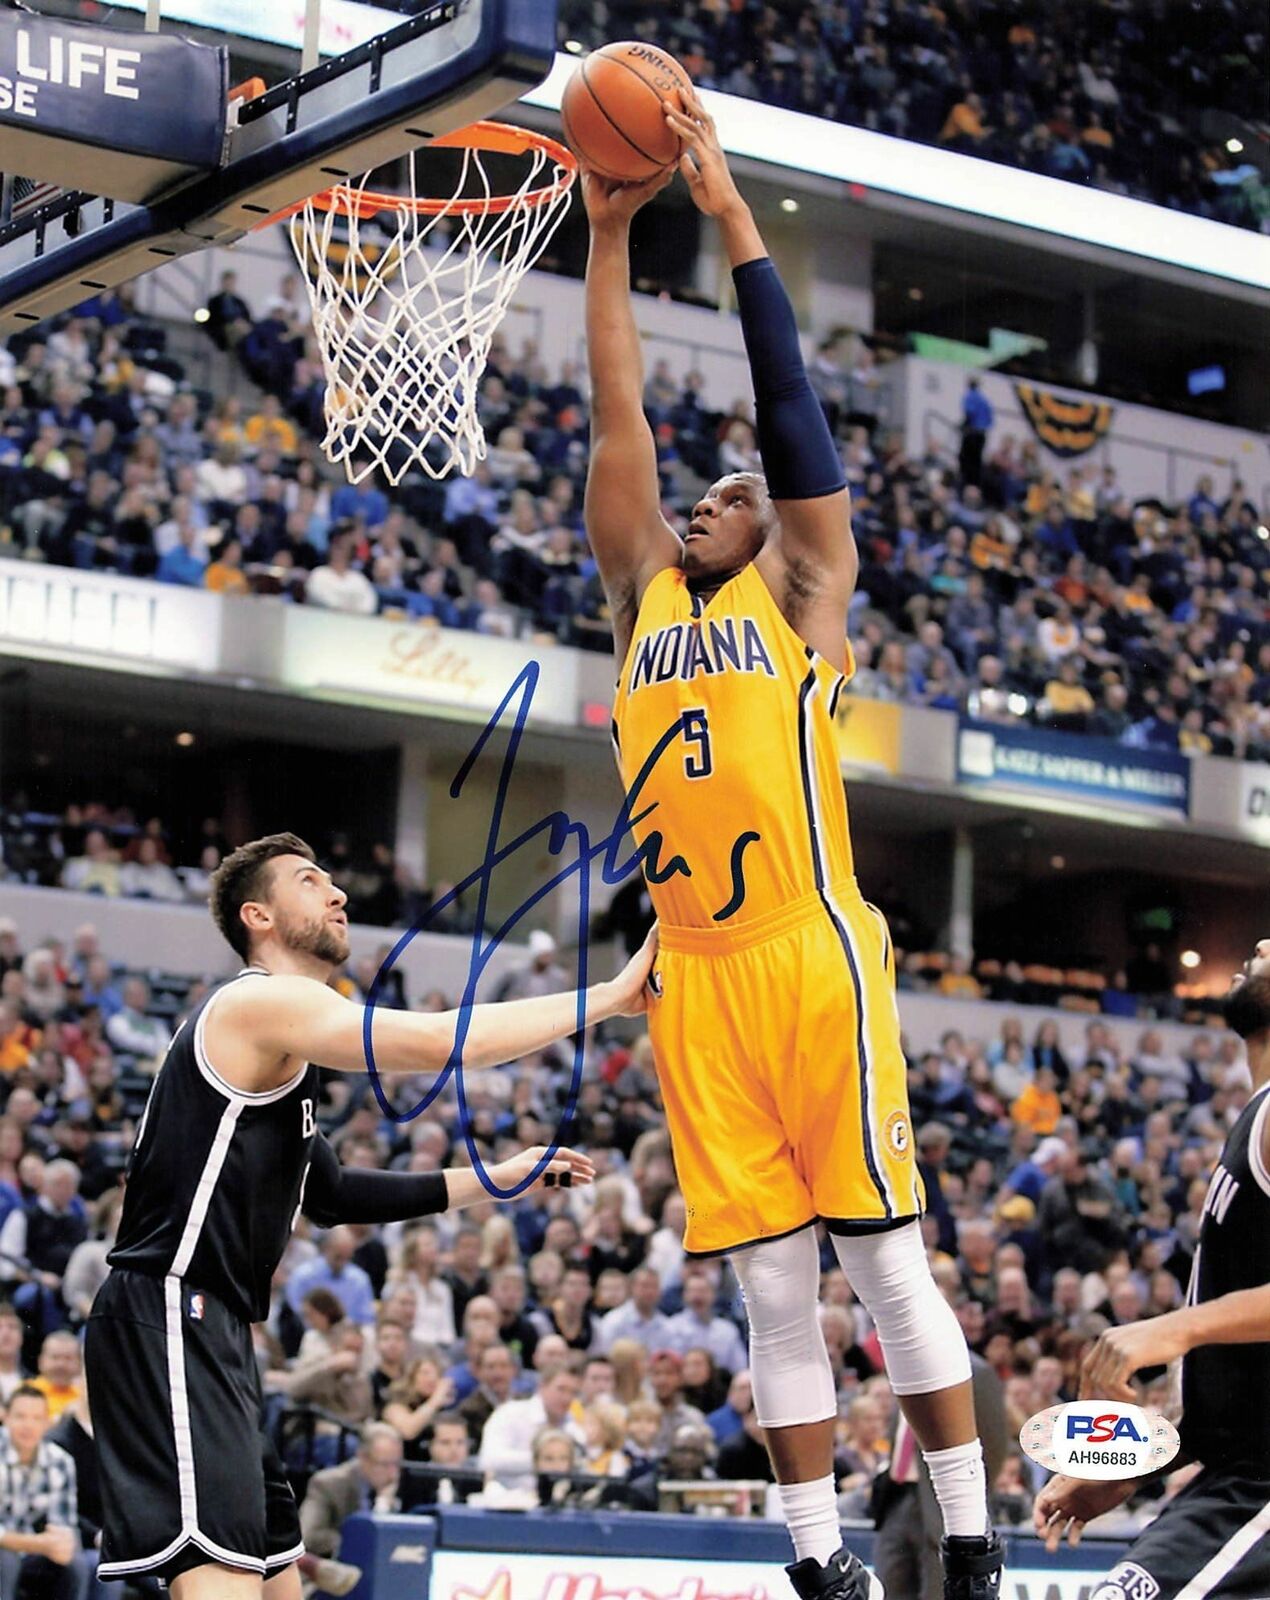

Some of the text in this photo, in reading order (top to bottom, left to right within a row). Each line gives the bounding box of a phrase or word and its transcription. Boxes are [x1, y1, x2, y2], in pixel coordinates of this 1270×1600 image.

[16, 29, 141, 100] LIFE
[627, 616, 778, 696] INDIANA
[681, 708, 712, 780] 5
